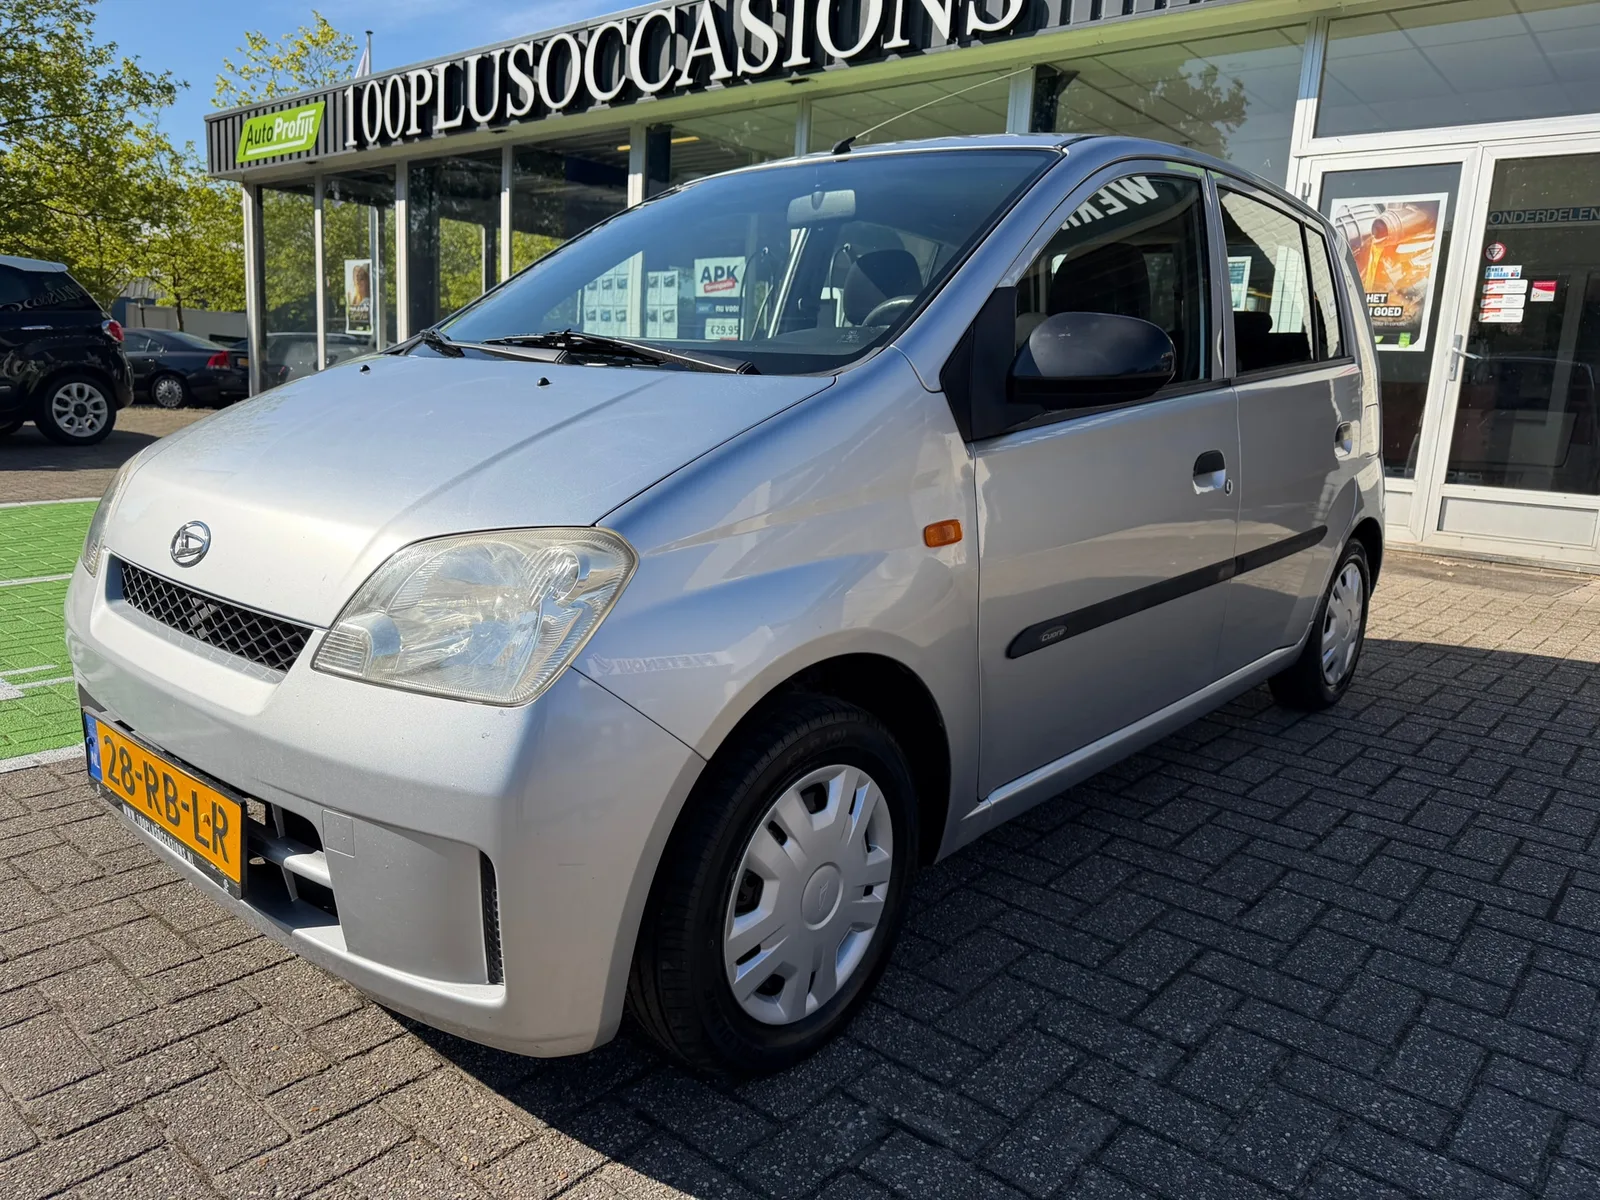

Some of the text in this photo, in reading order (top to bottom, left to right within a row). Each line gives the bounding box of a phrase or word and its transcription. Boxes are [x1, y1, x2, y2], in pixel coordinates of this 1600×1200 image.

[243, 109, 317, 155] AutoProfijt
[1489, 207, 1600, 224] ONDERDELEN
[700, 265, 739, 283] APK
[1366, 293, 1387, 303] HET
[1374, 307, 1402, 317] GOED
[91, 754, 101, 769] NL
[104, 734, 229, 864] 28-RB-LR
